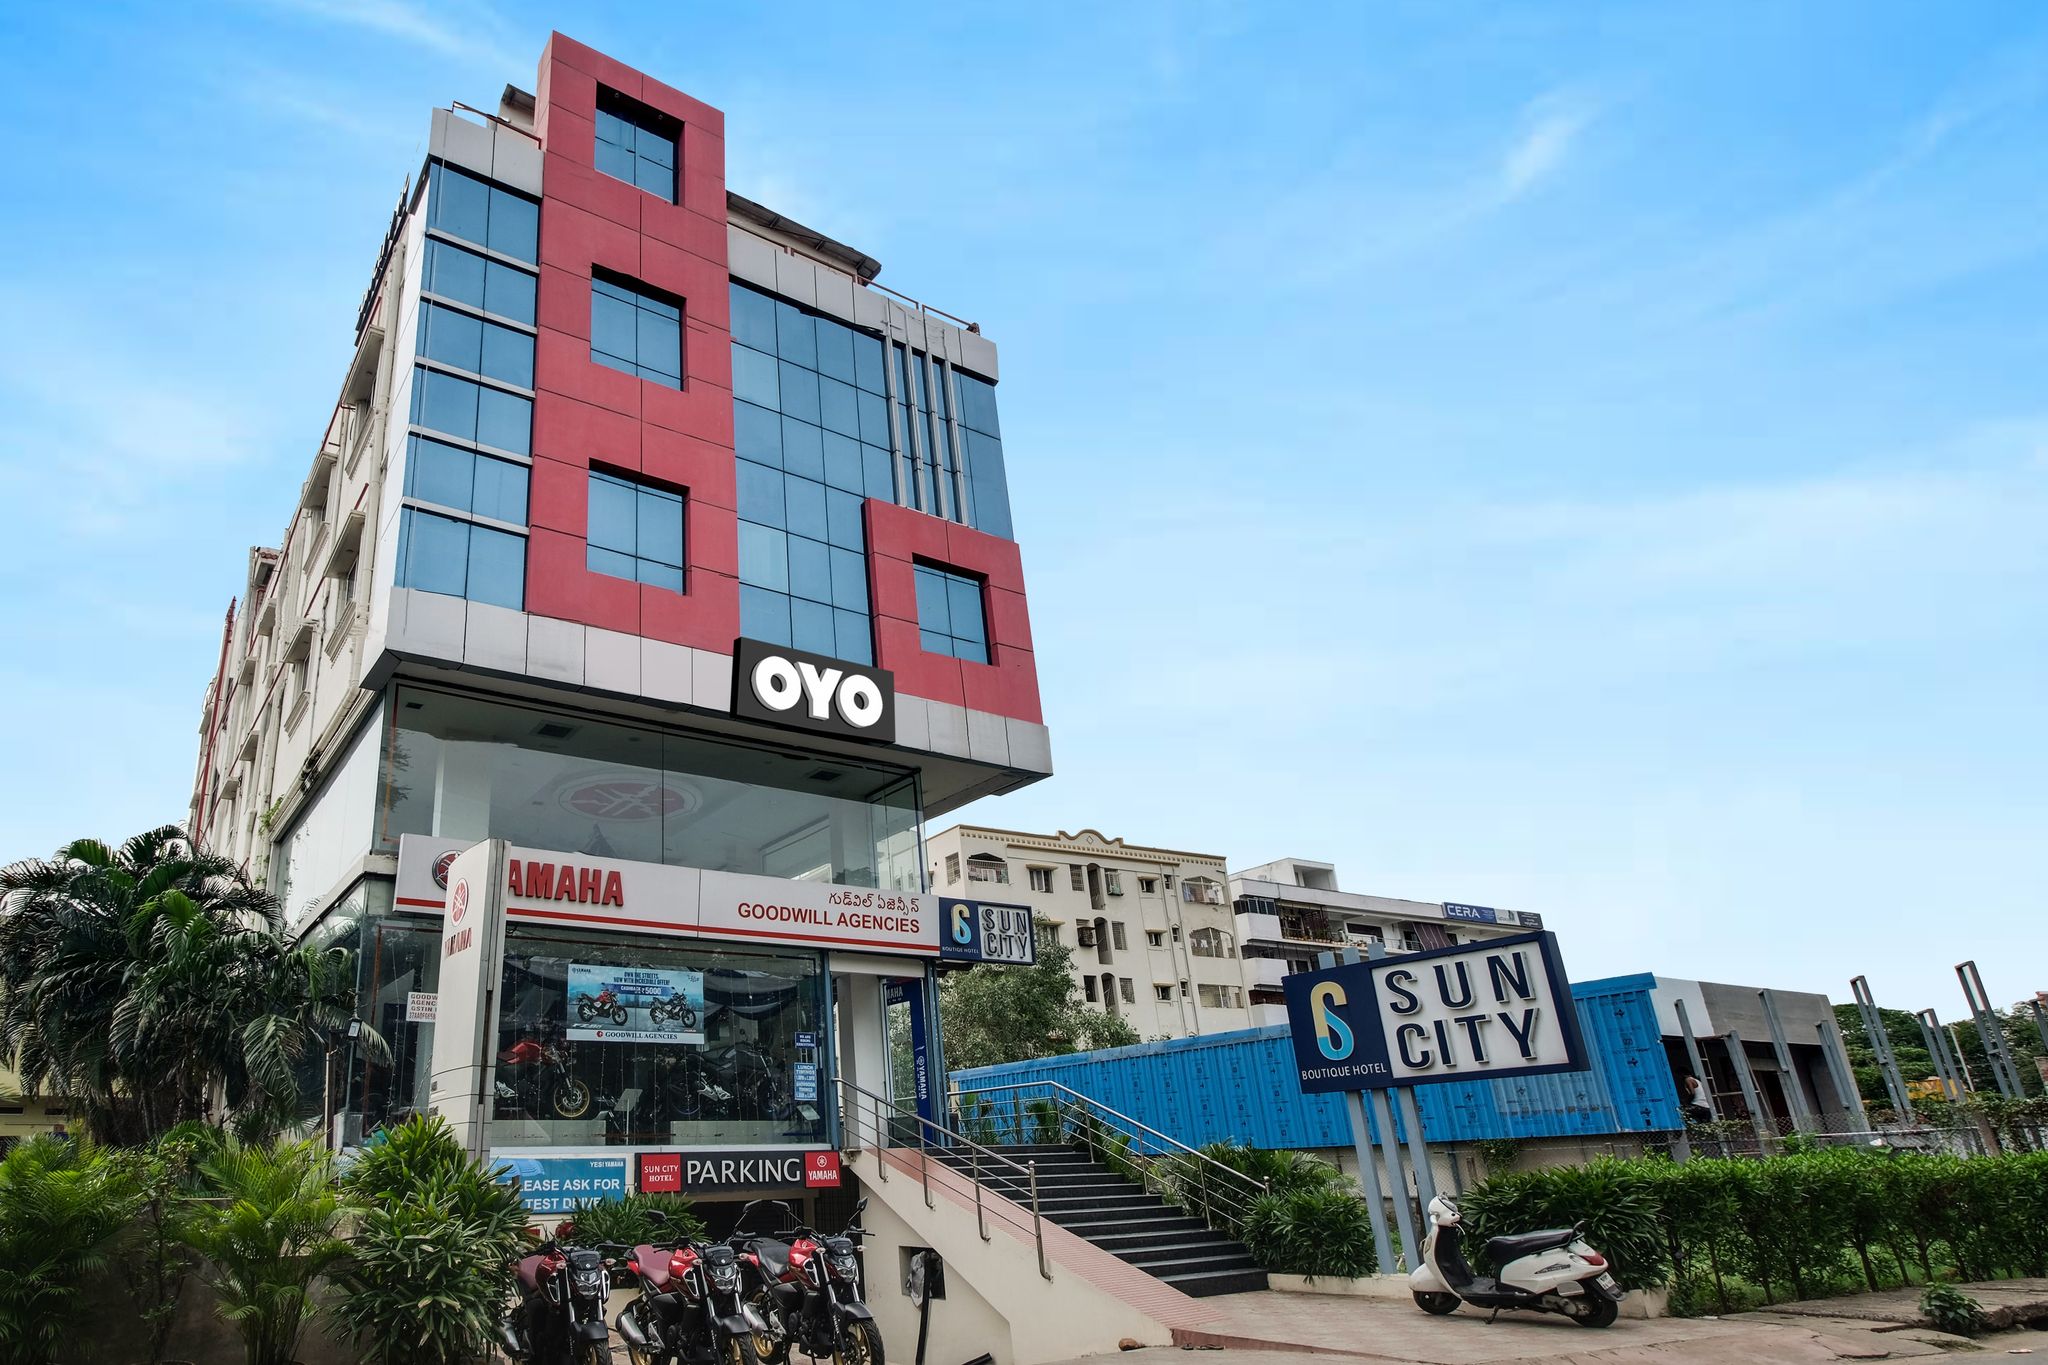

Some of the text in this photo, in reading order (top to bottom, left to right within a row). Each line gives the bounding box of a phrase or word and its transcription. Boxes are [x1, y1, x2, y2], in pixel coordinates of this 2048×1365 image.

[751, 656, 883, 728] OYO
[508, 859, 624, 907] AMAHA
[738, 902, 920, 934] GOODWILL AGENCIES
[982, 908, 1027, 935] SUN
[1447, 905, 1480, 918] CERA
[984, 933, 1027, 959] CITY
[886, 986, 904, 999] MAHA
[1385, 952, 1536, 1016] SUN
[1396, 1008, 1539, 1070] CITY
[919, 1066, 928, 1100] YAMAHA
[1302, 1062, 1387, 1081] BOUTIQUE HOTEL
[644, 1164, 679, 1173] SUN CITY
[687, 1158, 800, 1184] PARKING
[808, 1170, 837, 1181] YAMAHA
[519, 1179, 620, 1192] EASE ASK FOR
[525, 1197, 557, 1210] TEST
